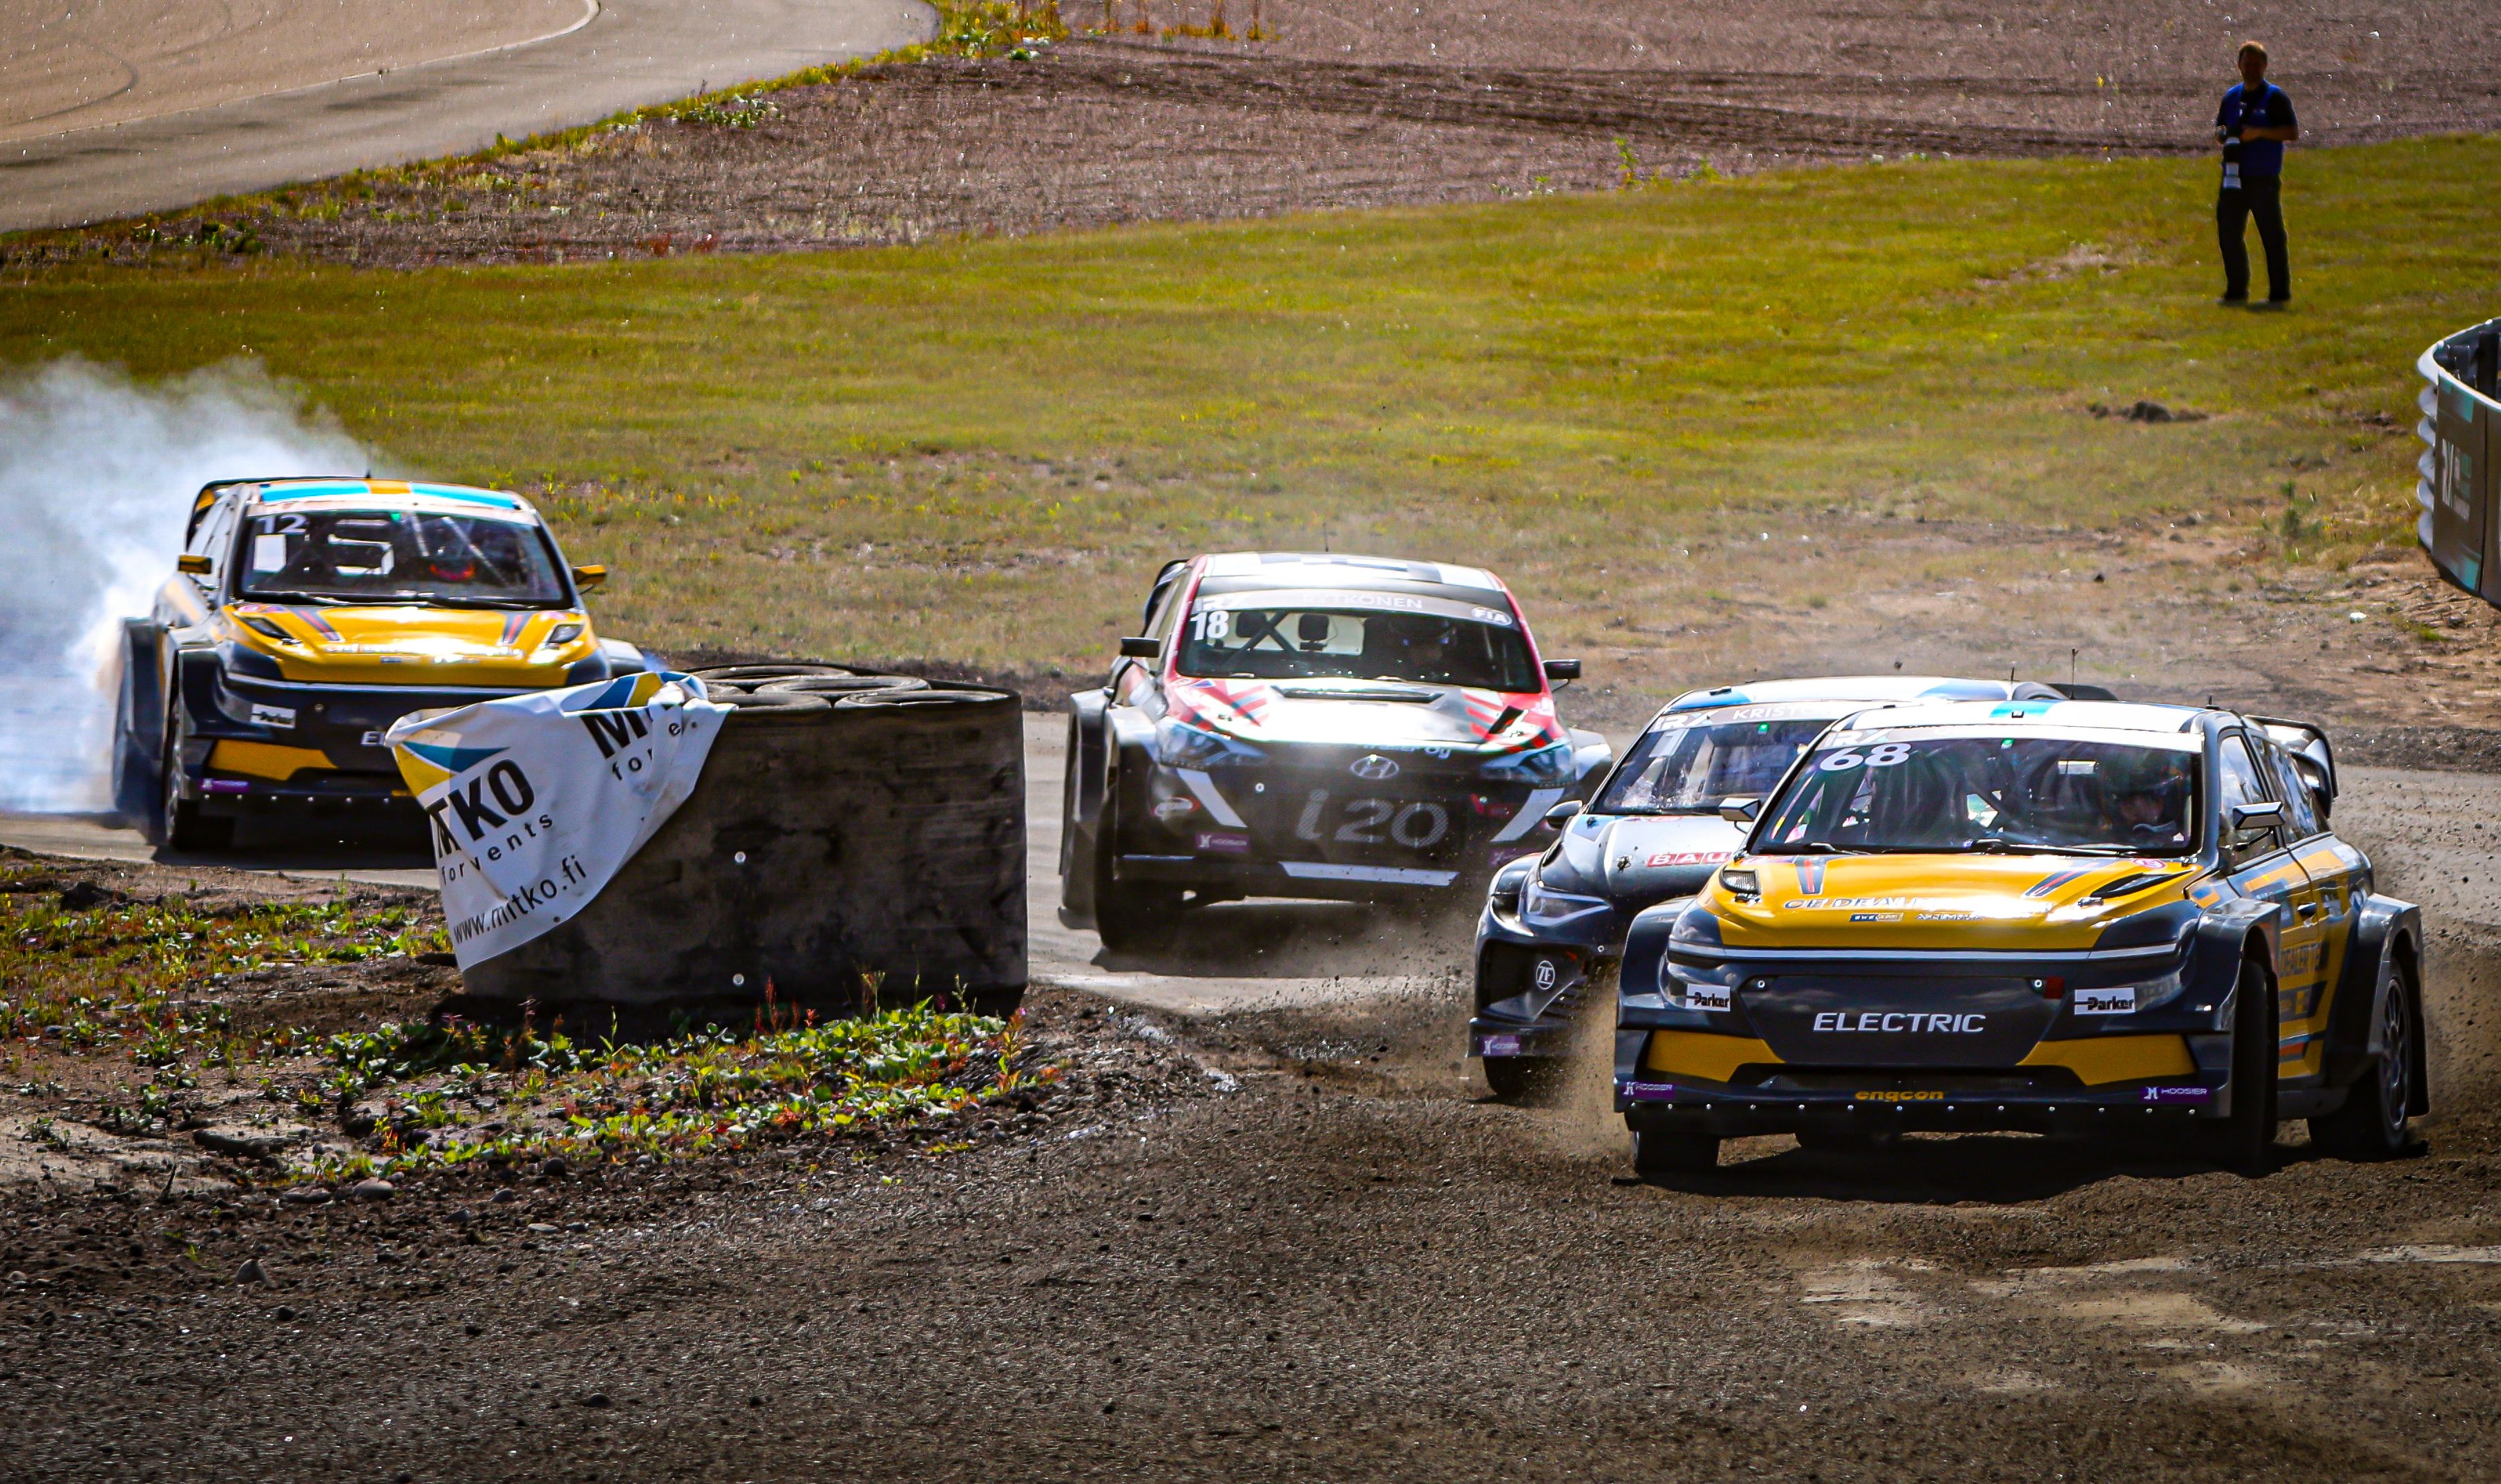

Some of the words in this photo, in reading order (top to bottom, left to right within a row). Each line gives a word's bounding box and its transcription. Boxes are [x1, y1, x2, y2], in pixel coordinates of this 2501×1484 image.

[257, 513, 306, 534] 12
[1474, 608, 1510, 624] FIA
[1189, 611, 1230, 640] 18
[1820, 743, 1911, 770] 68
[1694, 991, 1730, 1008] Parker
[2087, 996, 2135, 1010] Parker
[1812, 1012, 1986, 1033] ELECTRIC
[1855, 1091, 1944, 1102] engcon
[2160, 1087, 2208, 1096] HOOSIER
